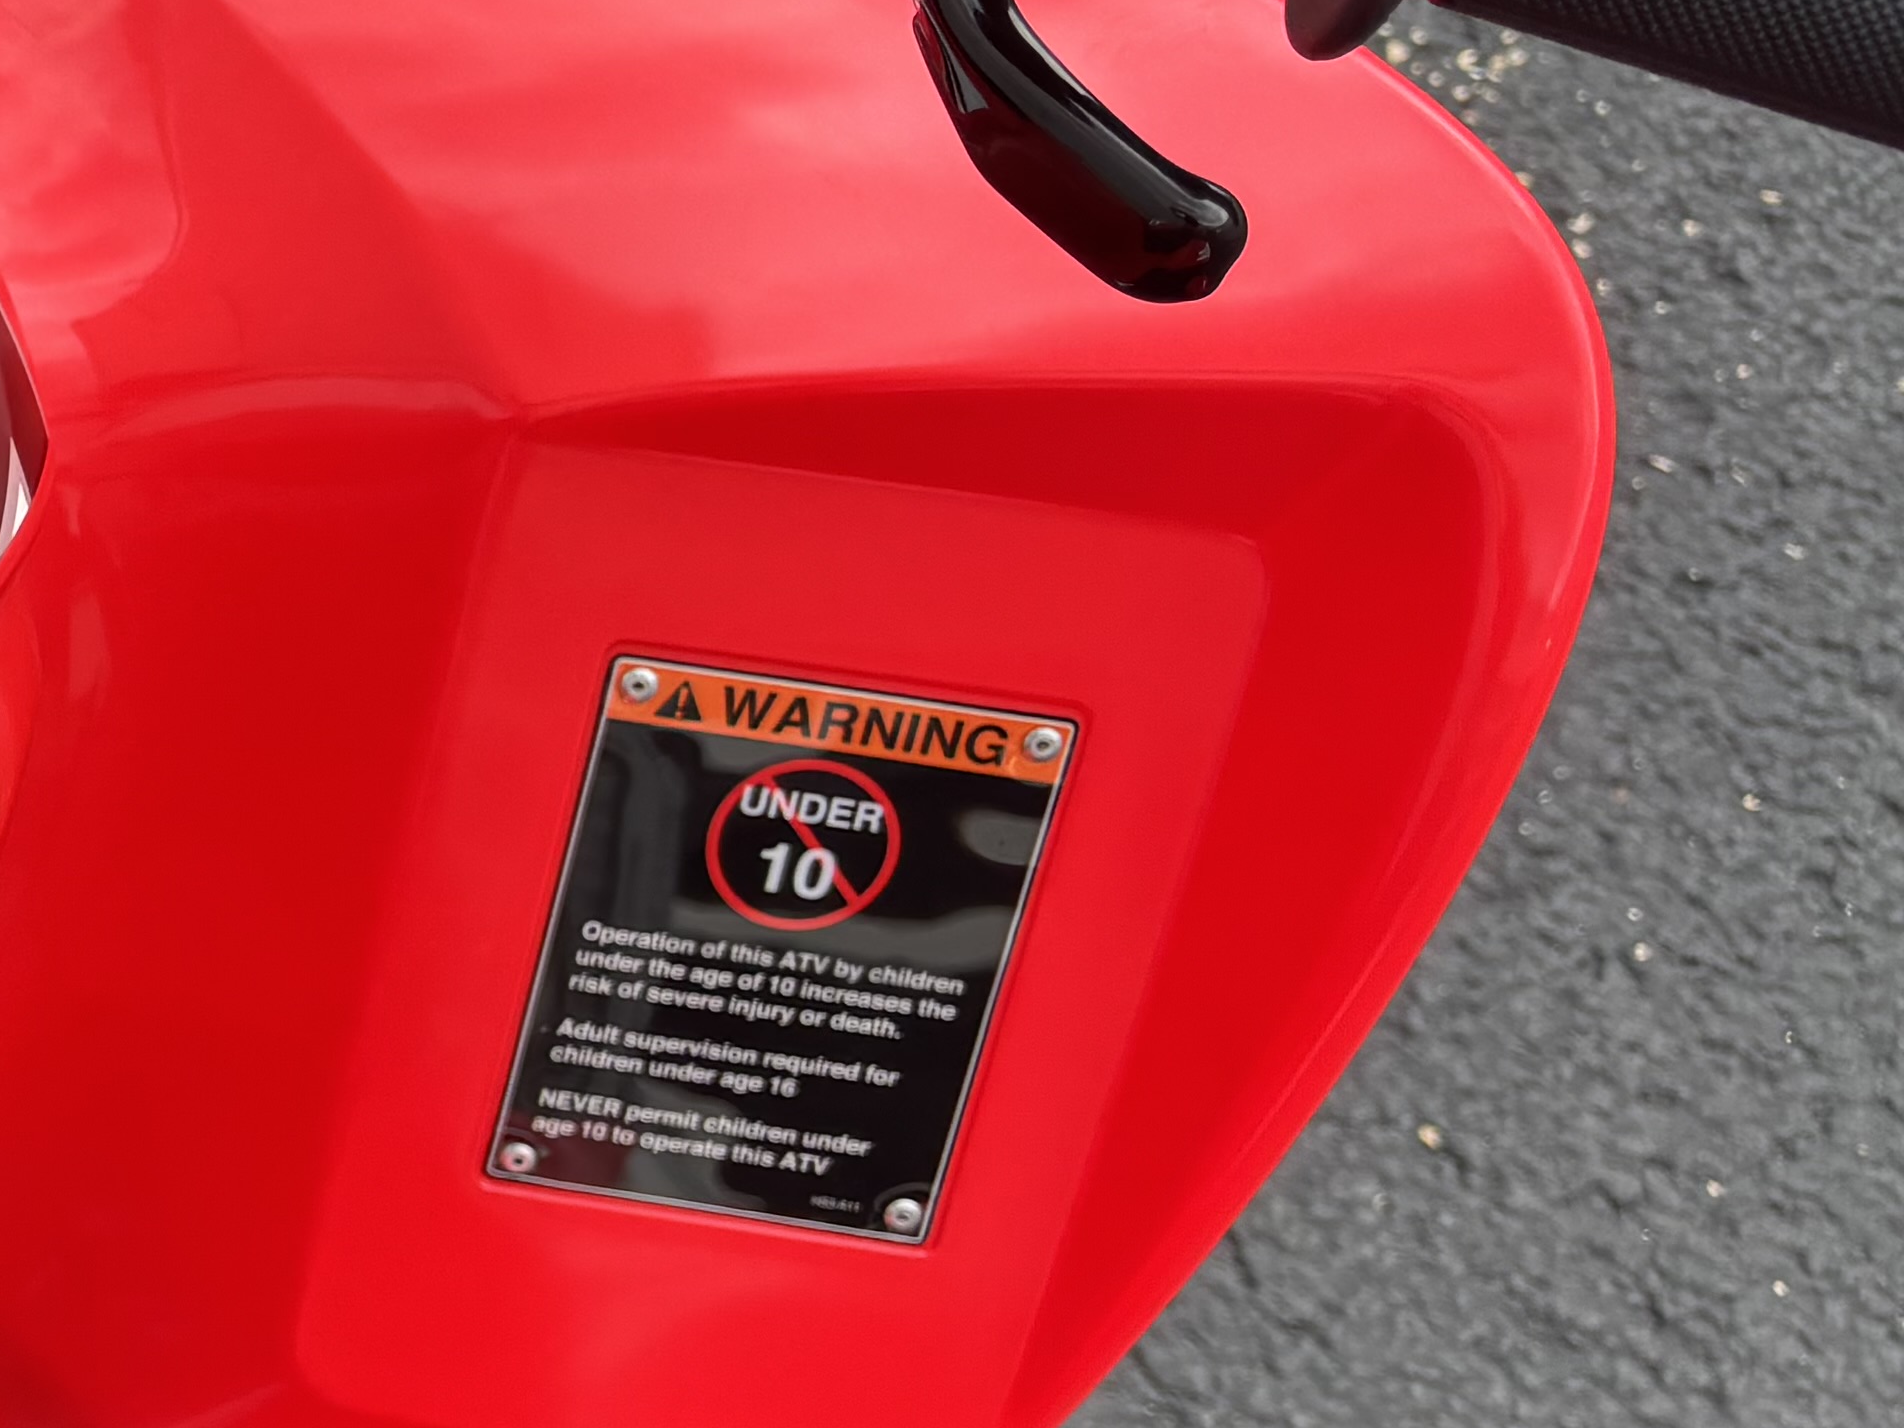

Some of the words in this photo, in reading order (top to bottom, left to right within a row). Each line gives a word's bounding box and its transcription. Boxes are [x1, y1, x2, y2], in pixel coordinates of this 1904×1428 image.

[724, 685, 1009, 767] WARNING
[740, 785, 884, 833] UNDER
[760, 842, 836, 900] 10
[575, 949, 645, 973] under
[647, 957, 687, 980] the
[688, 966, 734, 989] age
[736, 972, 766, 991] of
[769, 975, 796, 997] 10
[799, 978, 913, 1015] increases
[917, 998, 957, 1021] the
[581, 920, 696, 955] Operation
[700, 940, 727, 959] of
[730, 943, 774, 967] this
[778, 950, 830, 974] ATV
[833, 958, 864, 984] by
[867, 965, 964, 996] children
[568, 974, 613, 995] risk
[617, 980, 645, 1000] of
[645, 985, 725, 1012] severe
[727, 994, 796, 1026] injury
[798, 1009, 827, 1027] or
[549, 1044, 645, 1074] children
[648, 1060, 717, 1085] under
[719, 1071, 765, 1094] age
[770, 1076, 797, 1098] 16
[556, 1017, 621, 1045] Adult
[622, 1031, 758, 1066] supervision
[762, 1052, 862, 1081] required
[864, 1063, 900, 1087] for
[531, 1115, 576, 1138] age
[582, 1120, 608, 1141] 10
[611, 1125, 636, 1146] to
[639, 1131, 729, 1160] operate
[730, 1143, 776, 1167] this
[778, 1151, 830, 1176] ATV
[538, 1087, 623, 1118] NEVER
[623, 1104, 700, 1130] permit
[703, 1115, 797, 1145] children
[801, 1131, 872, 1157] under
